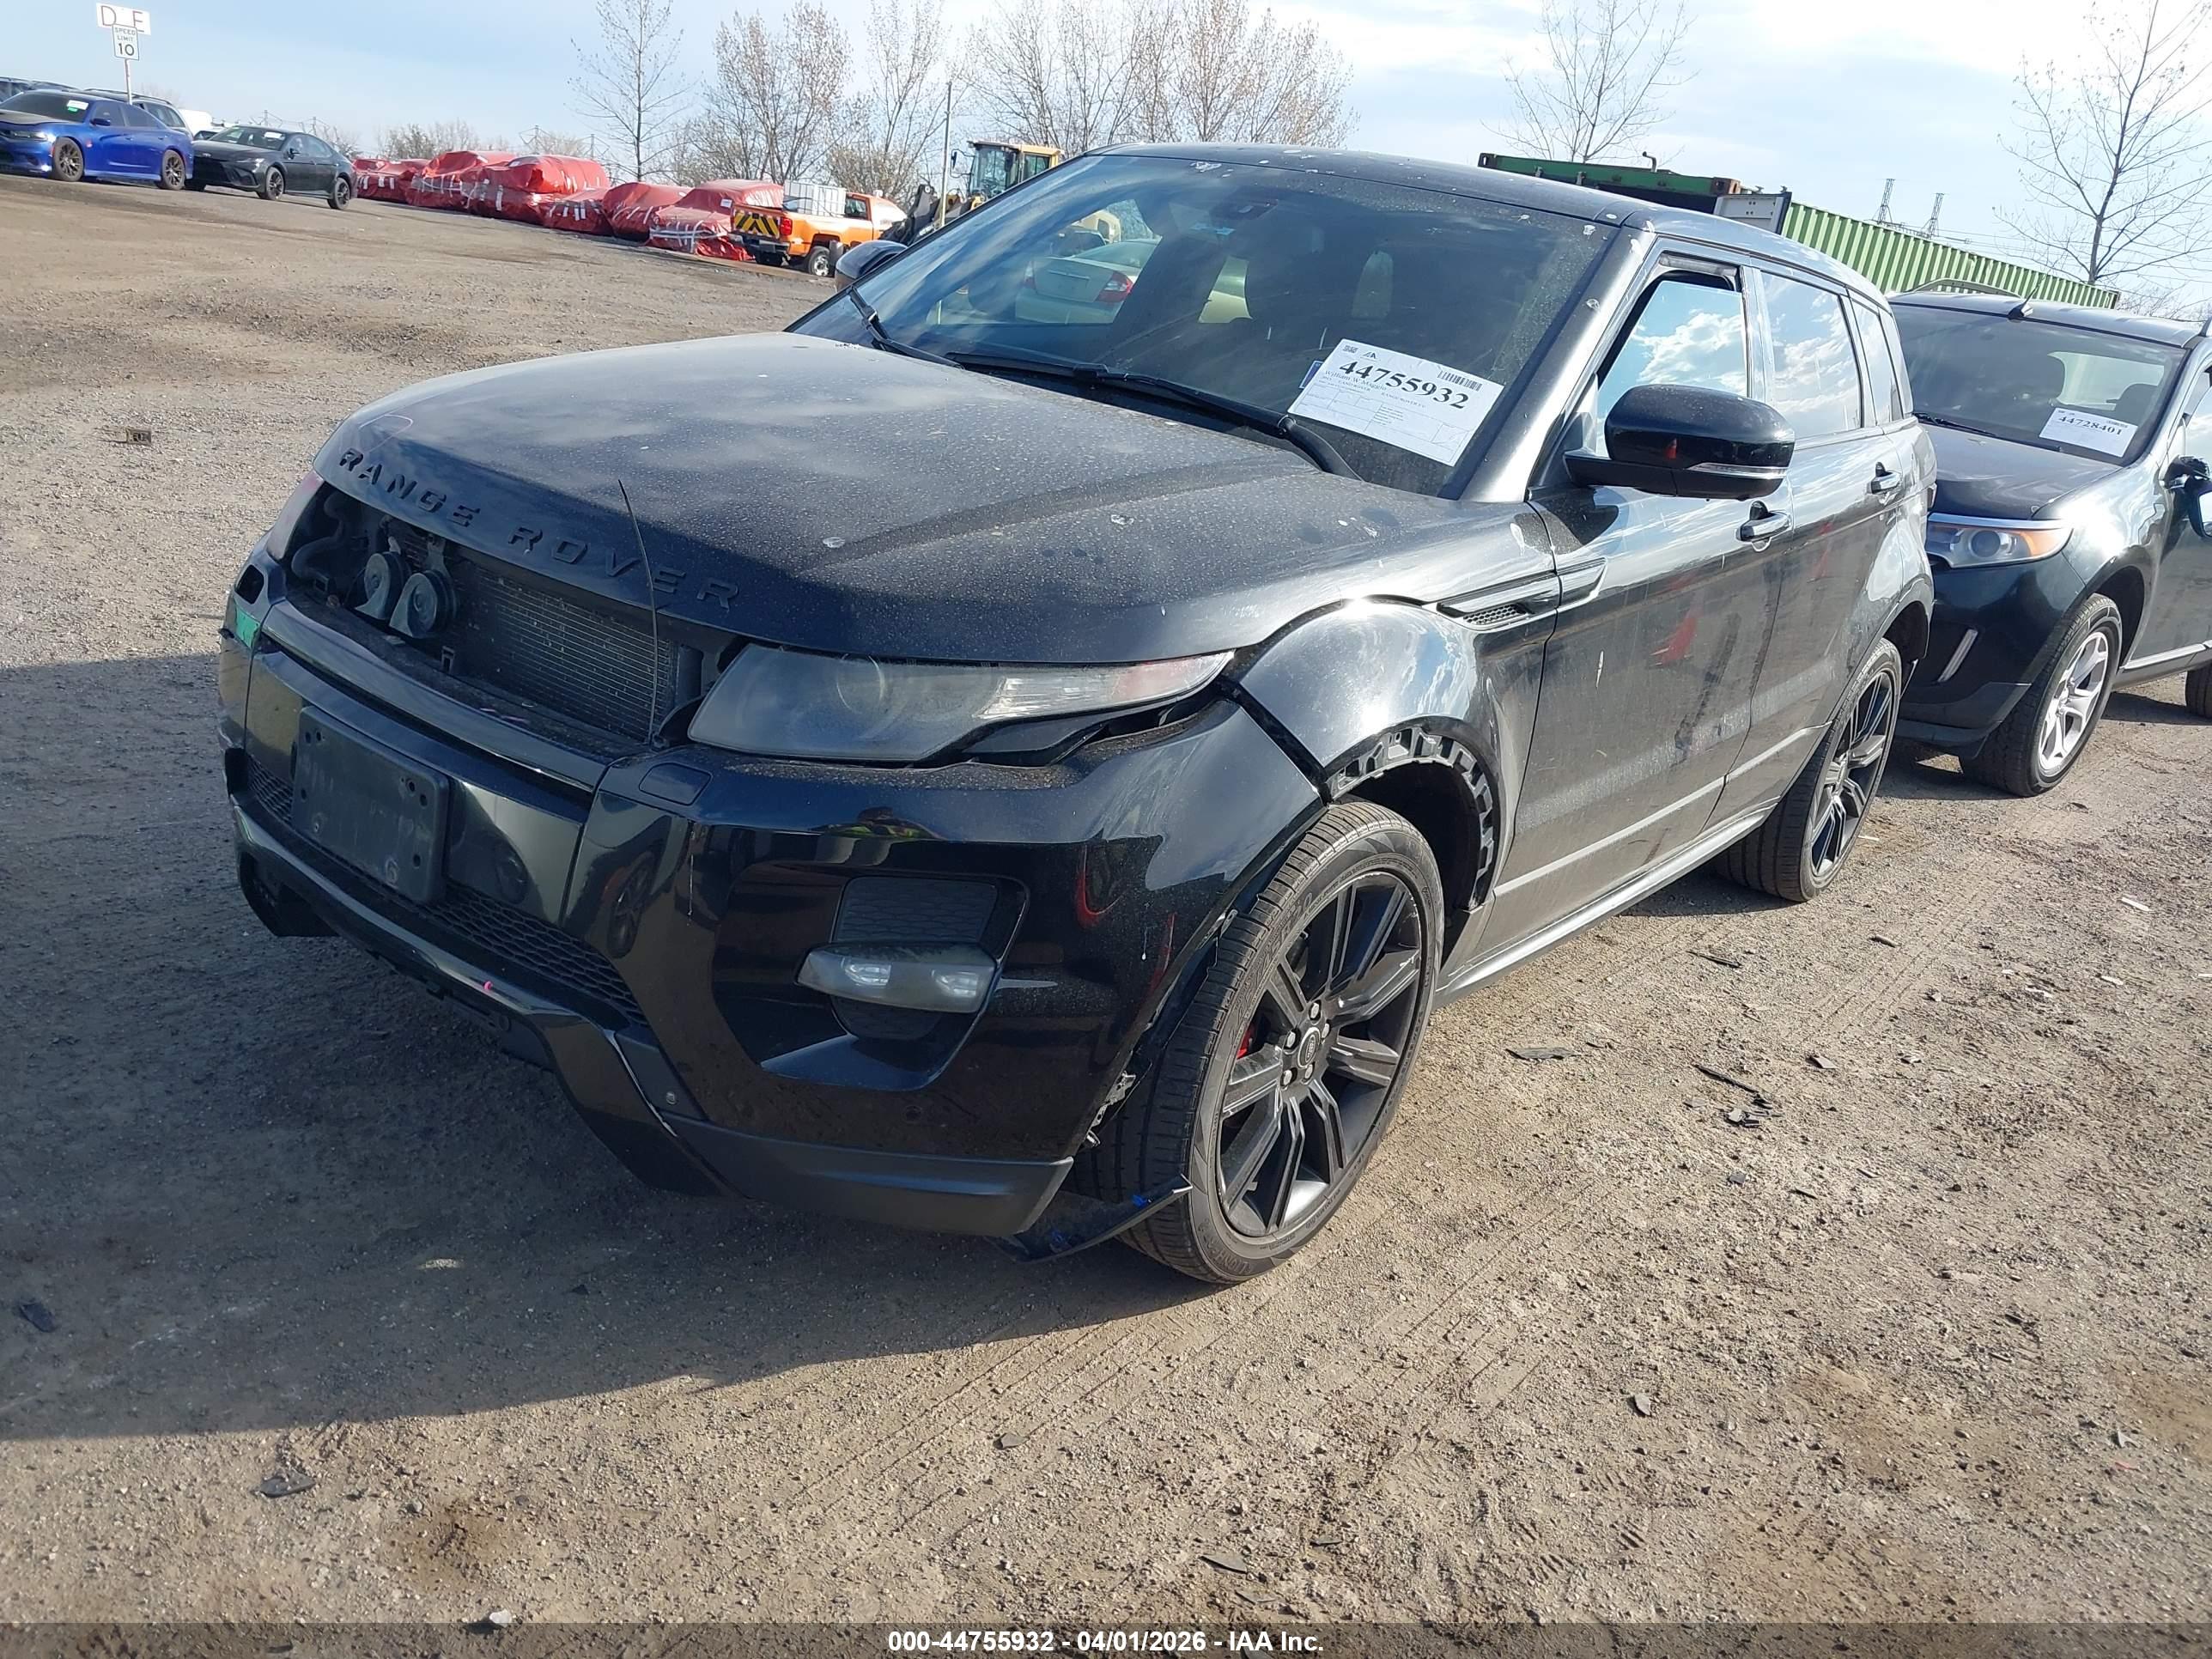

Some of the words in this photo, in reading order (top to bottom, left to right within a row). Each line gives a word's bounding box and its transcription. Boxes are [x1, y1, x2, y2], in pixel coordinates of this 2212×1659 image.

[100, 5, 117, 27] D
[114, 27, 137, 35] SPEED
[118, 43, 135, 56] 10
[1339, 361, 1469, 410] 44755932
[2058, 416, 2123, 435] 44728401
[338, 447, 481, 527] RANGE
[507, 526, 741, 612] ROVER
